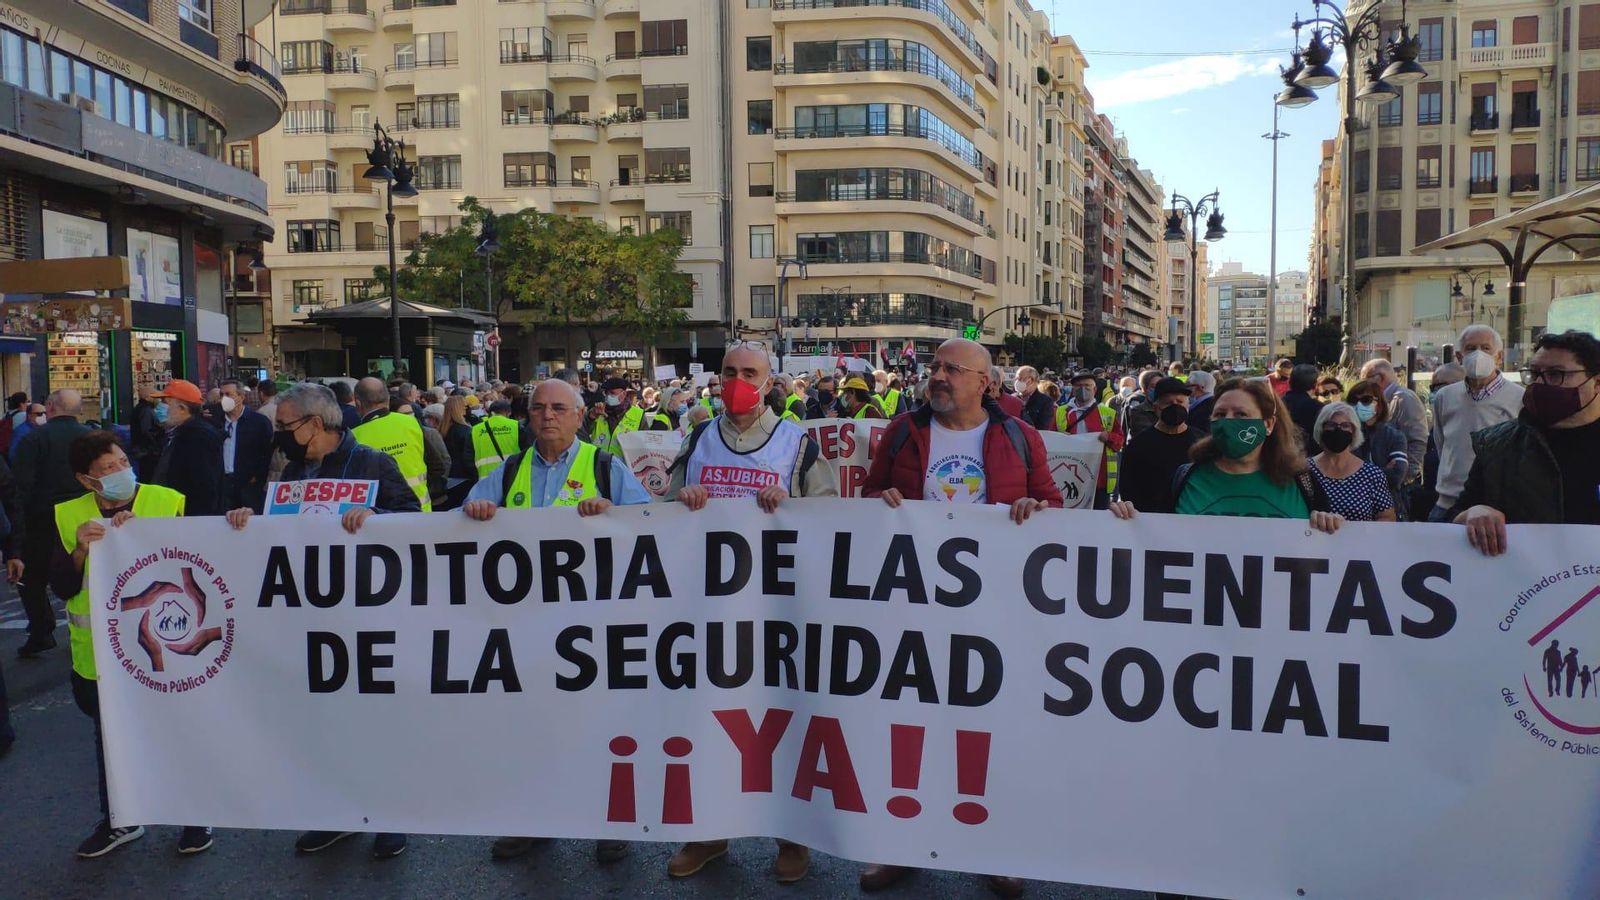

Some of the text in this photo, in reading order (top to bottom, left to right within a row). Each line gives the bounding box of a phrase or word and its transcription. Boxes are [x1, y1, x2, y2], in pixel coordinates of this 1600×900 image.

[96, 50, 132, 75] COCINAS
[159, 79, 199, 105] PAVIMENTOS
[702, 468, 776, 487] ASJUBI40
[106, 547, 235, 611] Coordinadora Valenciana por la
[257, 530, 1458, 640] AUDITORIA DE LAS CUENTAS
[1499, 570, 1571, 632] Coordinadora
[107, 617, 235, 693] Defensa del Sistema Público de Pensiones
[307, 620, 1390, 742] DE LA SEGURIDAD SOCIAL
[1501, 687, 1519, 707] del
[1514, 709, 1557, 748] Sistema
